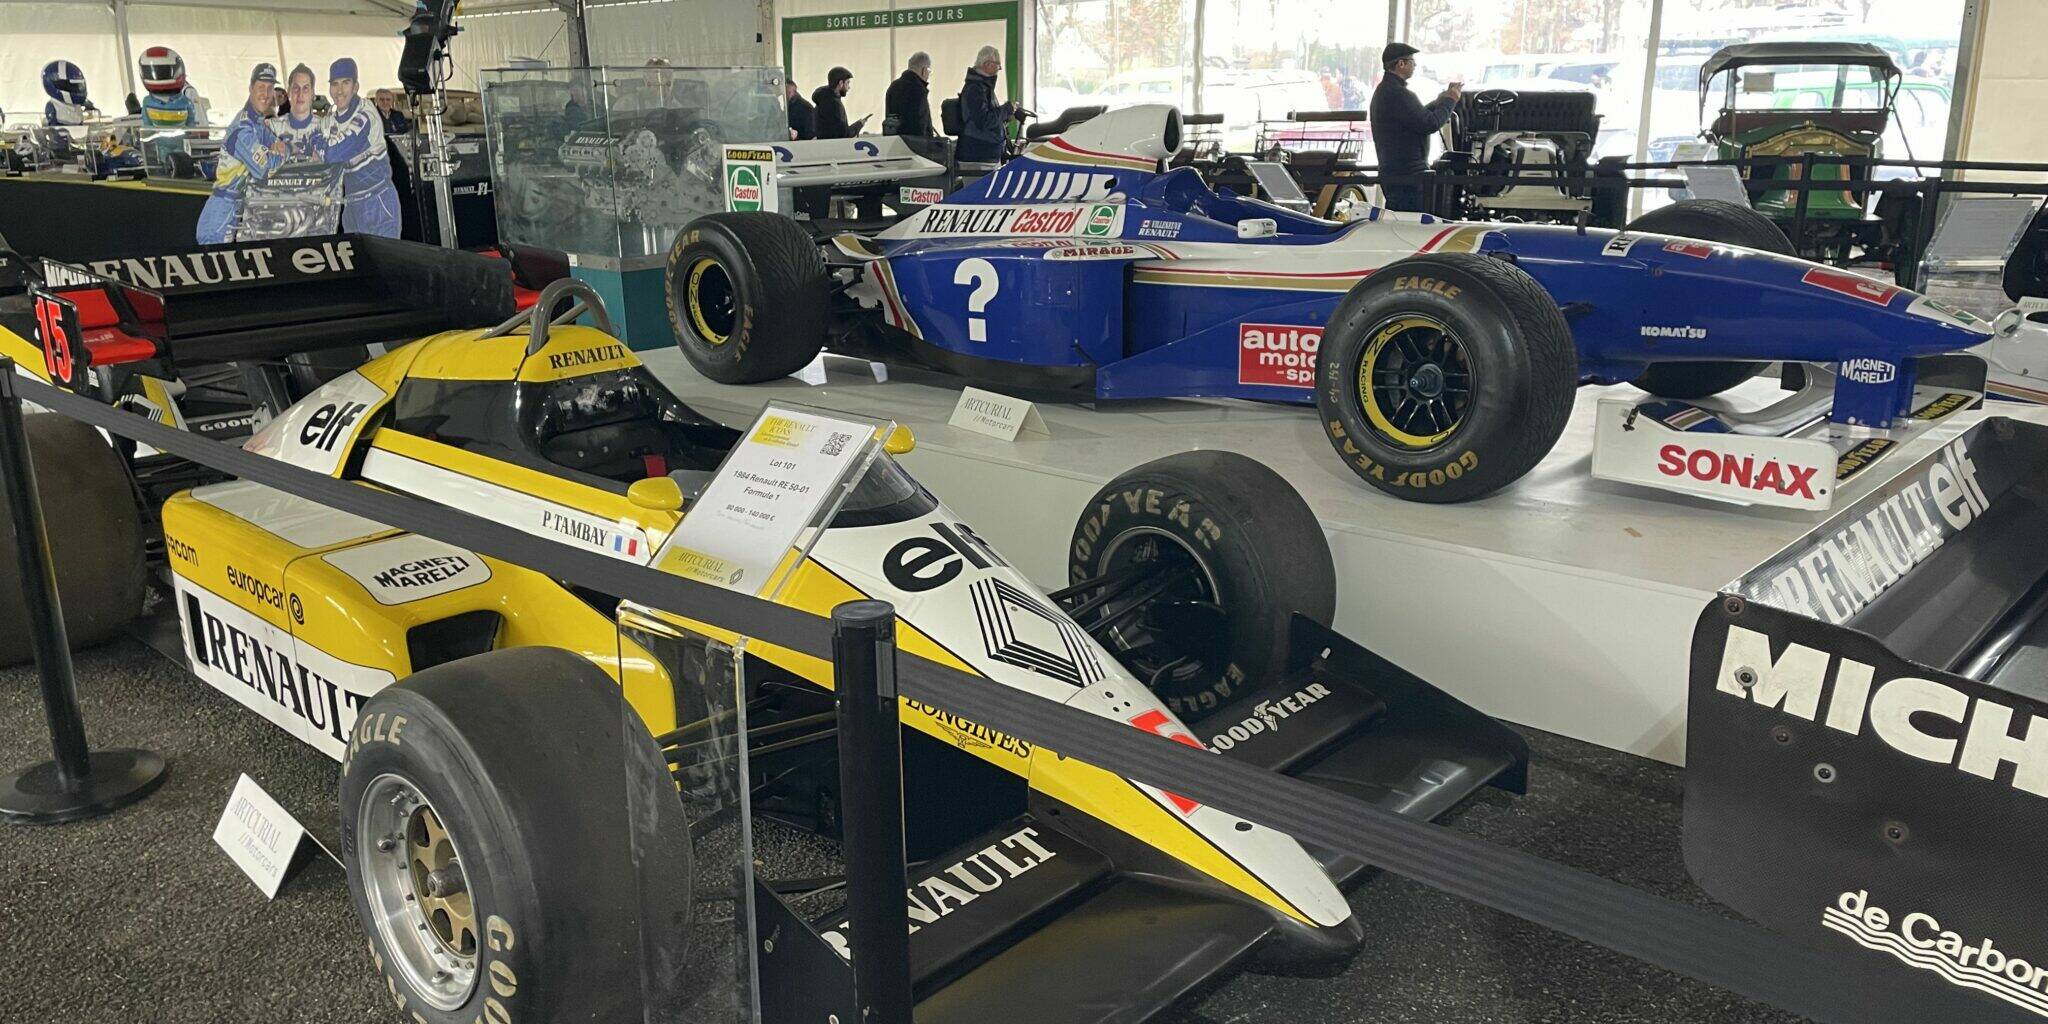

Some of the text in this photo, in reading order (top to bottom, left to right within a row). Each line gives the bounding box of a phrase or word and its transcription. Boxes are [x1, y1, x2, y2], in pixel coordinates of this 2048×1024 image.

[827, 9, 964, 28] SORTIE DE SECOURS
[267, 178, 302, 186] RENAULT
[735, 186, 759, 200] Castrol
[911, 188, 943, 204] Castrol
[920, 207, 1083, 233] RENAULT Castrol
[1138, 228, 1179, 238] RENAULT
[72, 242, 354, 288] ENAULT elf
[1063, 246, 1134, 258] MIRAGE
[1393, 276, 1462, 299] EAGLE
[35, 297, 72, 383] 15
[1243, 330, 1321, 352] auto
[1641, 325, 1707, 339] KOMATSU
[548, 345, 625, 369] RENAULT
[1360, 359, 1369, 404] RACING
[963, 397, 1012, 420] ARTCURIAL
[300, 402, 368, 452] elf
[770, 458, 797, 471] Lot 101
[1329, 419, 1479, 488] GOODYEAR
[733, 470, 749, 479] 1984
[750, 474, 779, 487] Renault
[778, 480, 789, 489] RE
[1657, 444, 1818, 500] SONAX
[743, 486, 774, 500] Formule
[1772, 436, 1991, 625] RENAULT elf
[882, 522, 1010, 593] elf
[373, 556, 470, 588] MAGNETI
[373, 560, 470, 588] MARELLI
[227, 565, 284, 611] europcar
[230, 796, 281, 855] ARTCURIAL
[821, 827, 1057, 961] NAULT
[1839, 890, 1890, 931] de
